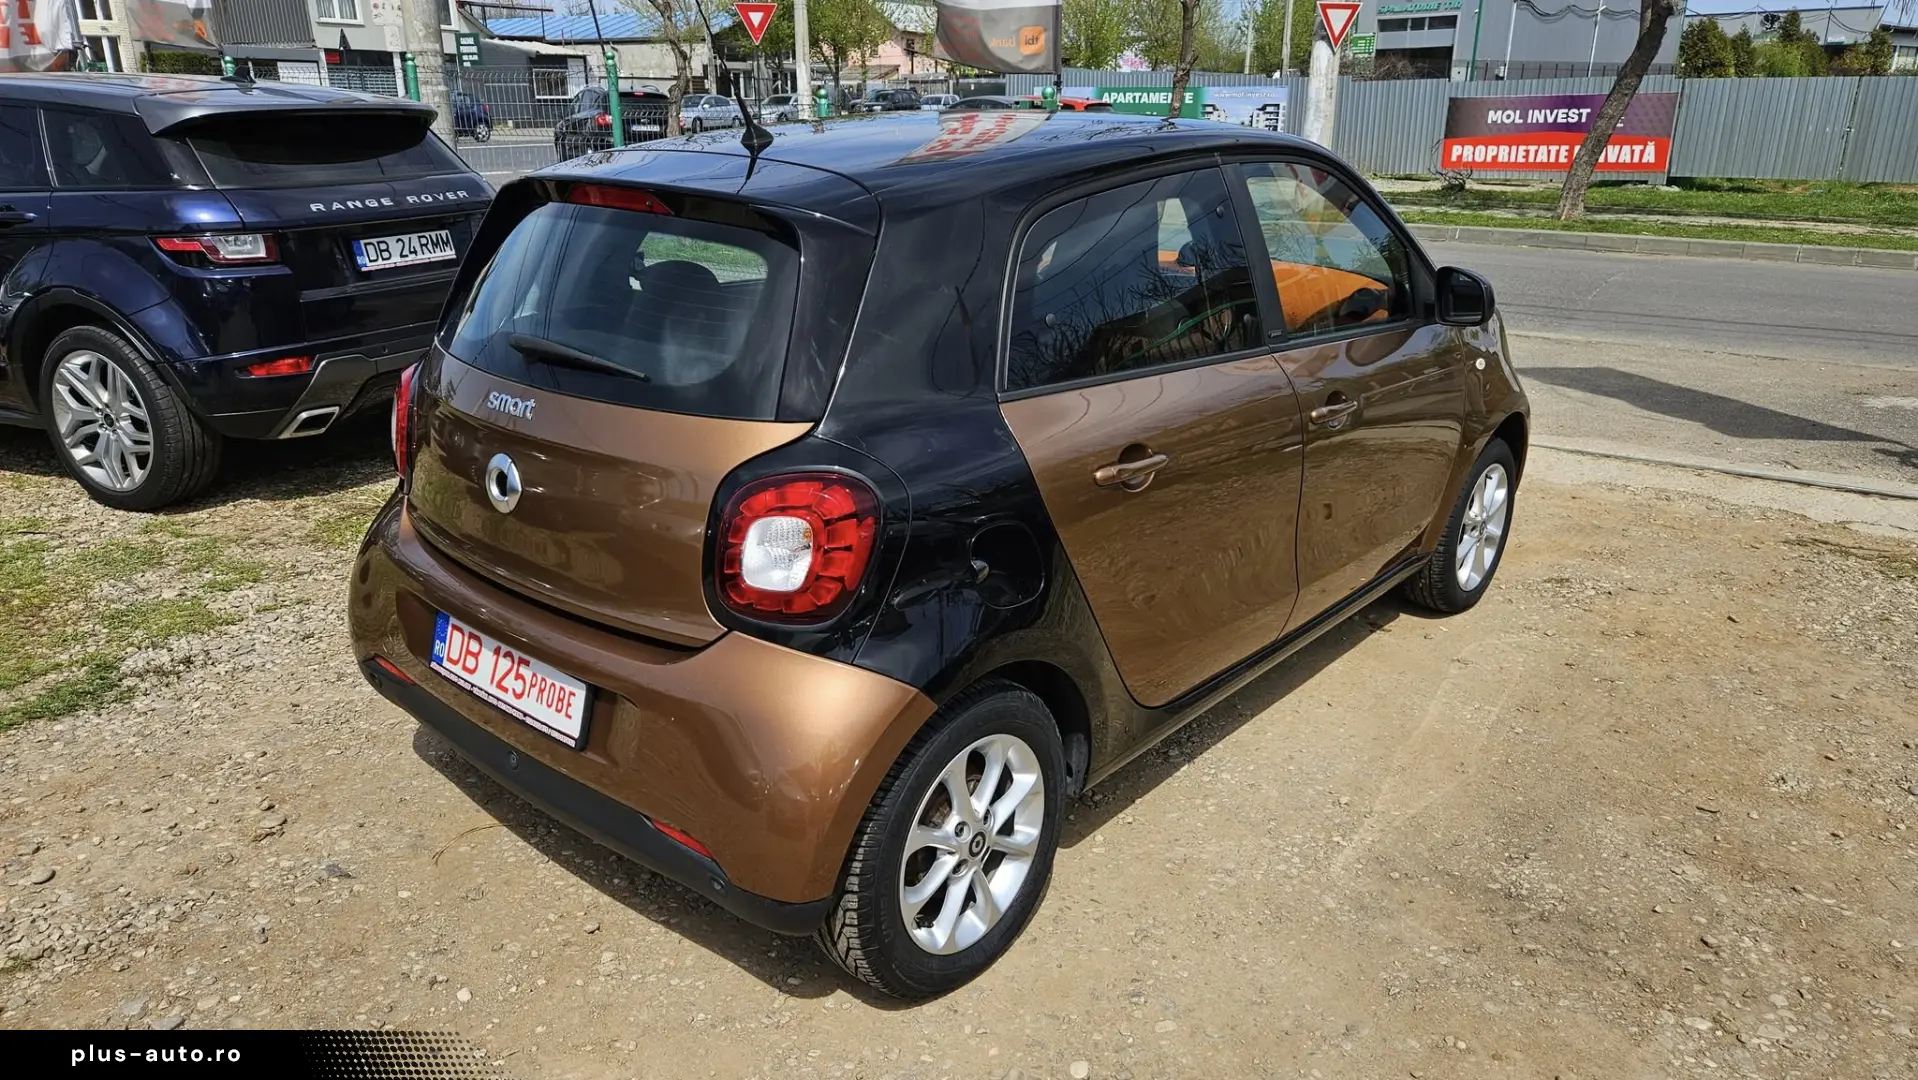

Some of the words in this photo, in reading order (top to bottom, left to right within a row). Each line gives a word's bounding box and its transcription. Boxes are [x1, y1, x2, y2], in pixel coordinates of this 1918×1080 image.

[1102, 92, 1194, 104] APARTAMEE
[1488, 109, 1523, 124] MOL
[1527, 108, 1591, 123] INVEST
[1451, 144, 1569, 163] PROPRIETATE
[309, 197, 394, 212] RANGE
[406, 190, 469, 204] ROVER
[363, 240, 392, 263] DB
[487, 391, 536, 420] smart
[434, 640, 446, 658] RO
[446, 623, 483, 675] DB
